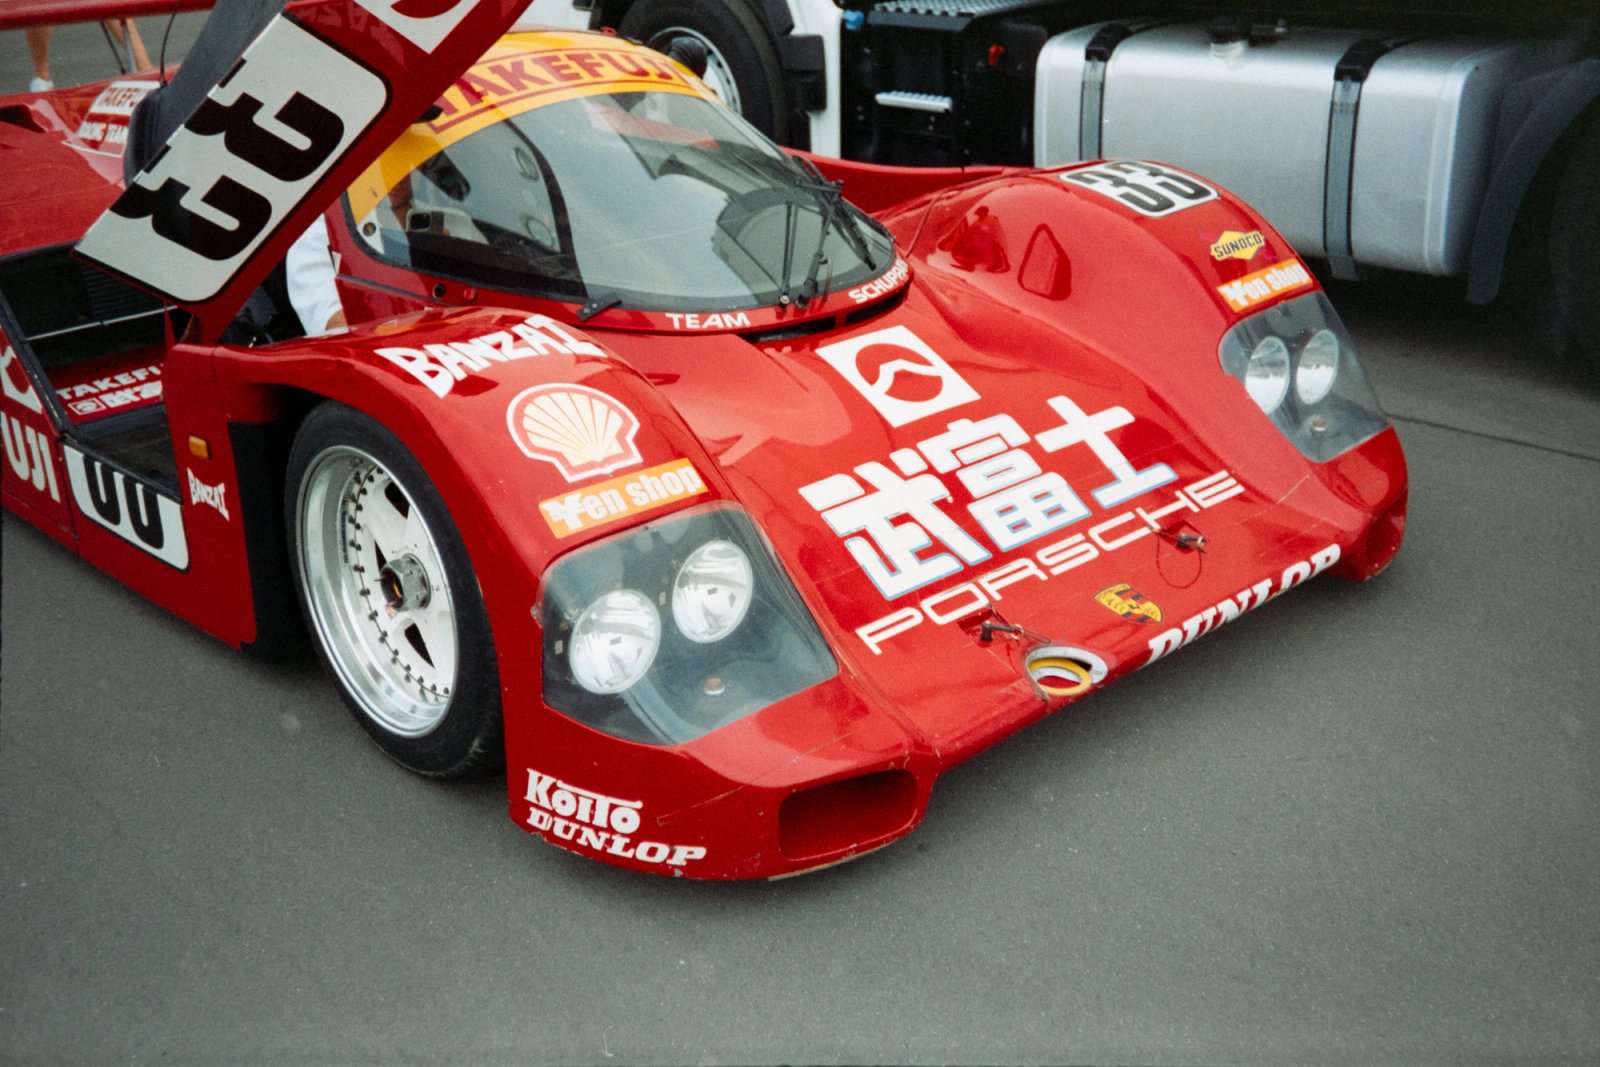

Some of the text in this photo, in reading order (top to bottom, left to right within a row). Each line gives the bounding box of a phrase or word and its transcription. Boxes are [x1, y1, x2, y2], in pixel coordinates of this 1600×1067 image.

[1066, 159, 1213, 215] 33
[1213, 233, 1263, 258] SUNOCO
[1265, 263, 1310, 291] shop
[665, 311, 752, 330] TEAM
[374, 314, 609, 399] BANZAI
[627, 464, 703, 506] shop
[798, 395, 1179, 600] 武富士
[855, 470, 1246, 655] PORSCHE
[526, 806, 708, 866] DUNLOP
